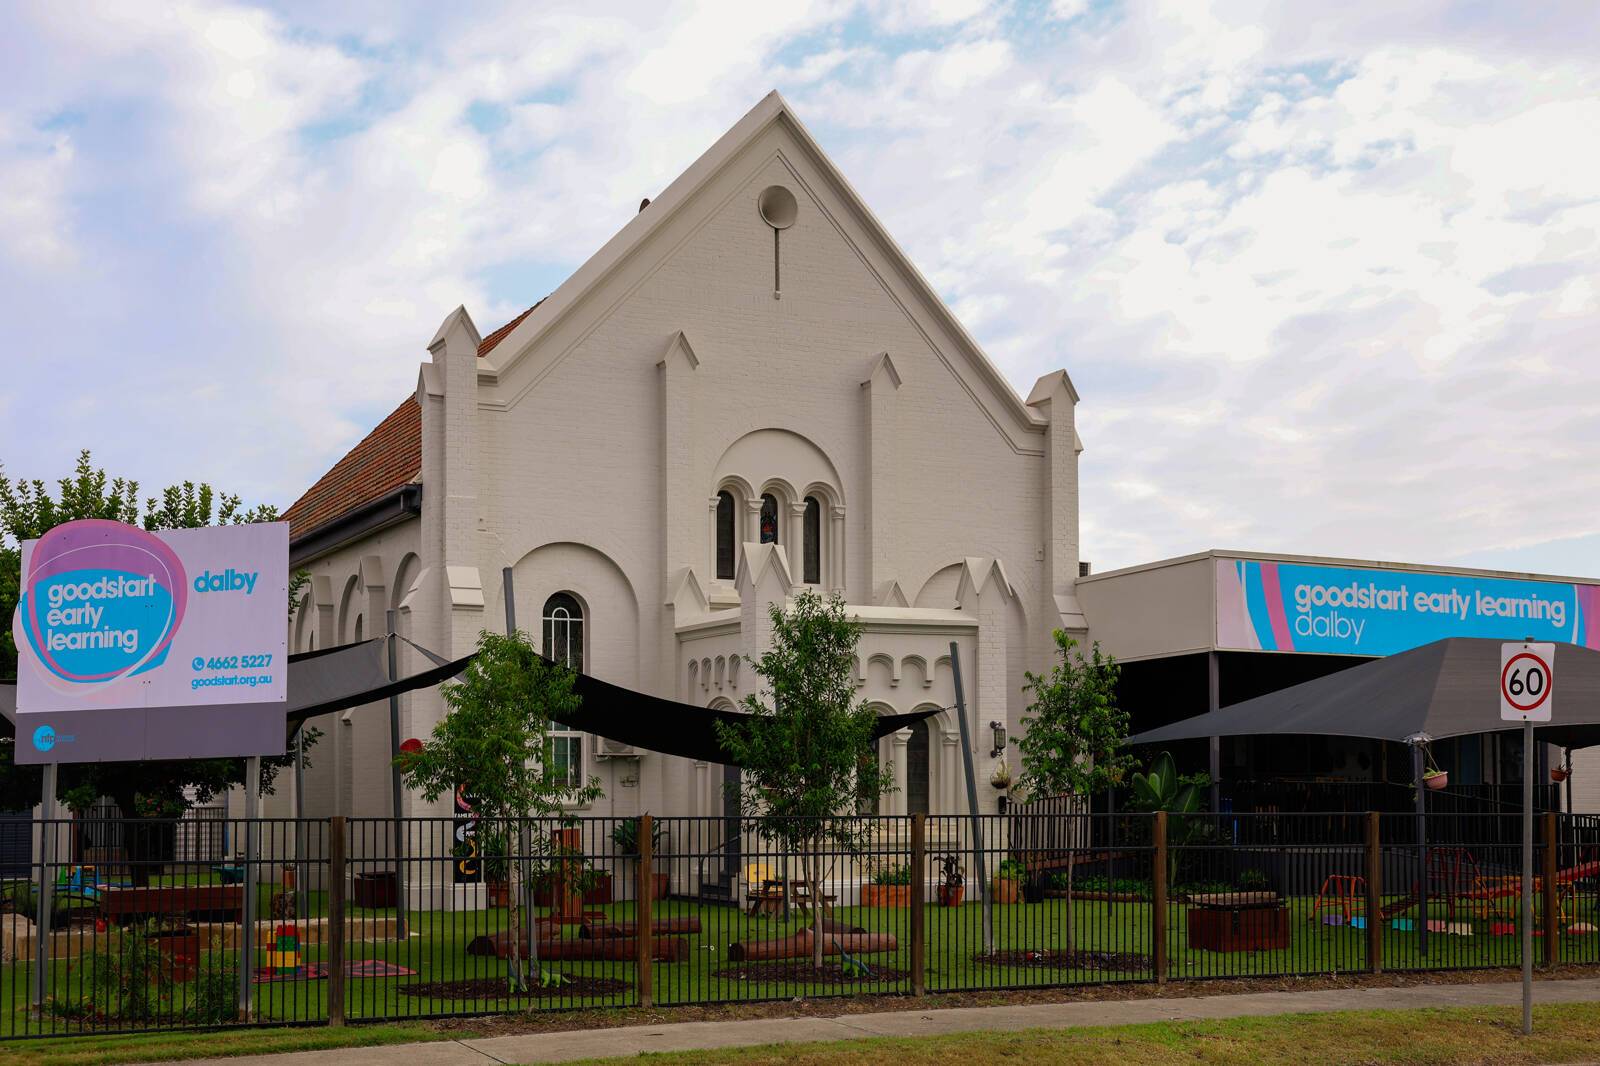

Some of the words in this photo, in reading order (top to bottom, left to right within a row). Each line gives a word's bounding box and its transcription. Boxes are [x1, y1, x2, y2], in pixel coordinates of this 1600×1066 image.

[48, 573, 157, 609] goodstart
[194, 569, 259, 595] dalby
[46, 602, 105, 629] early
[1295, 582, 1409, 613] goodstart
[1413, 588, 1471, 621] early
[1475, 590, 1566, 628] learning
[46, 625, 139, 654] learning
[1295, 610, 1366, 645] dalby
[206, 656, 239, 670] 4662
[241, 653, 273, 668] 5227
[191, 675, 273, 690] goodstart.org.au
[1509, 667, 1544, 696] 60
